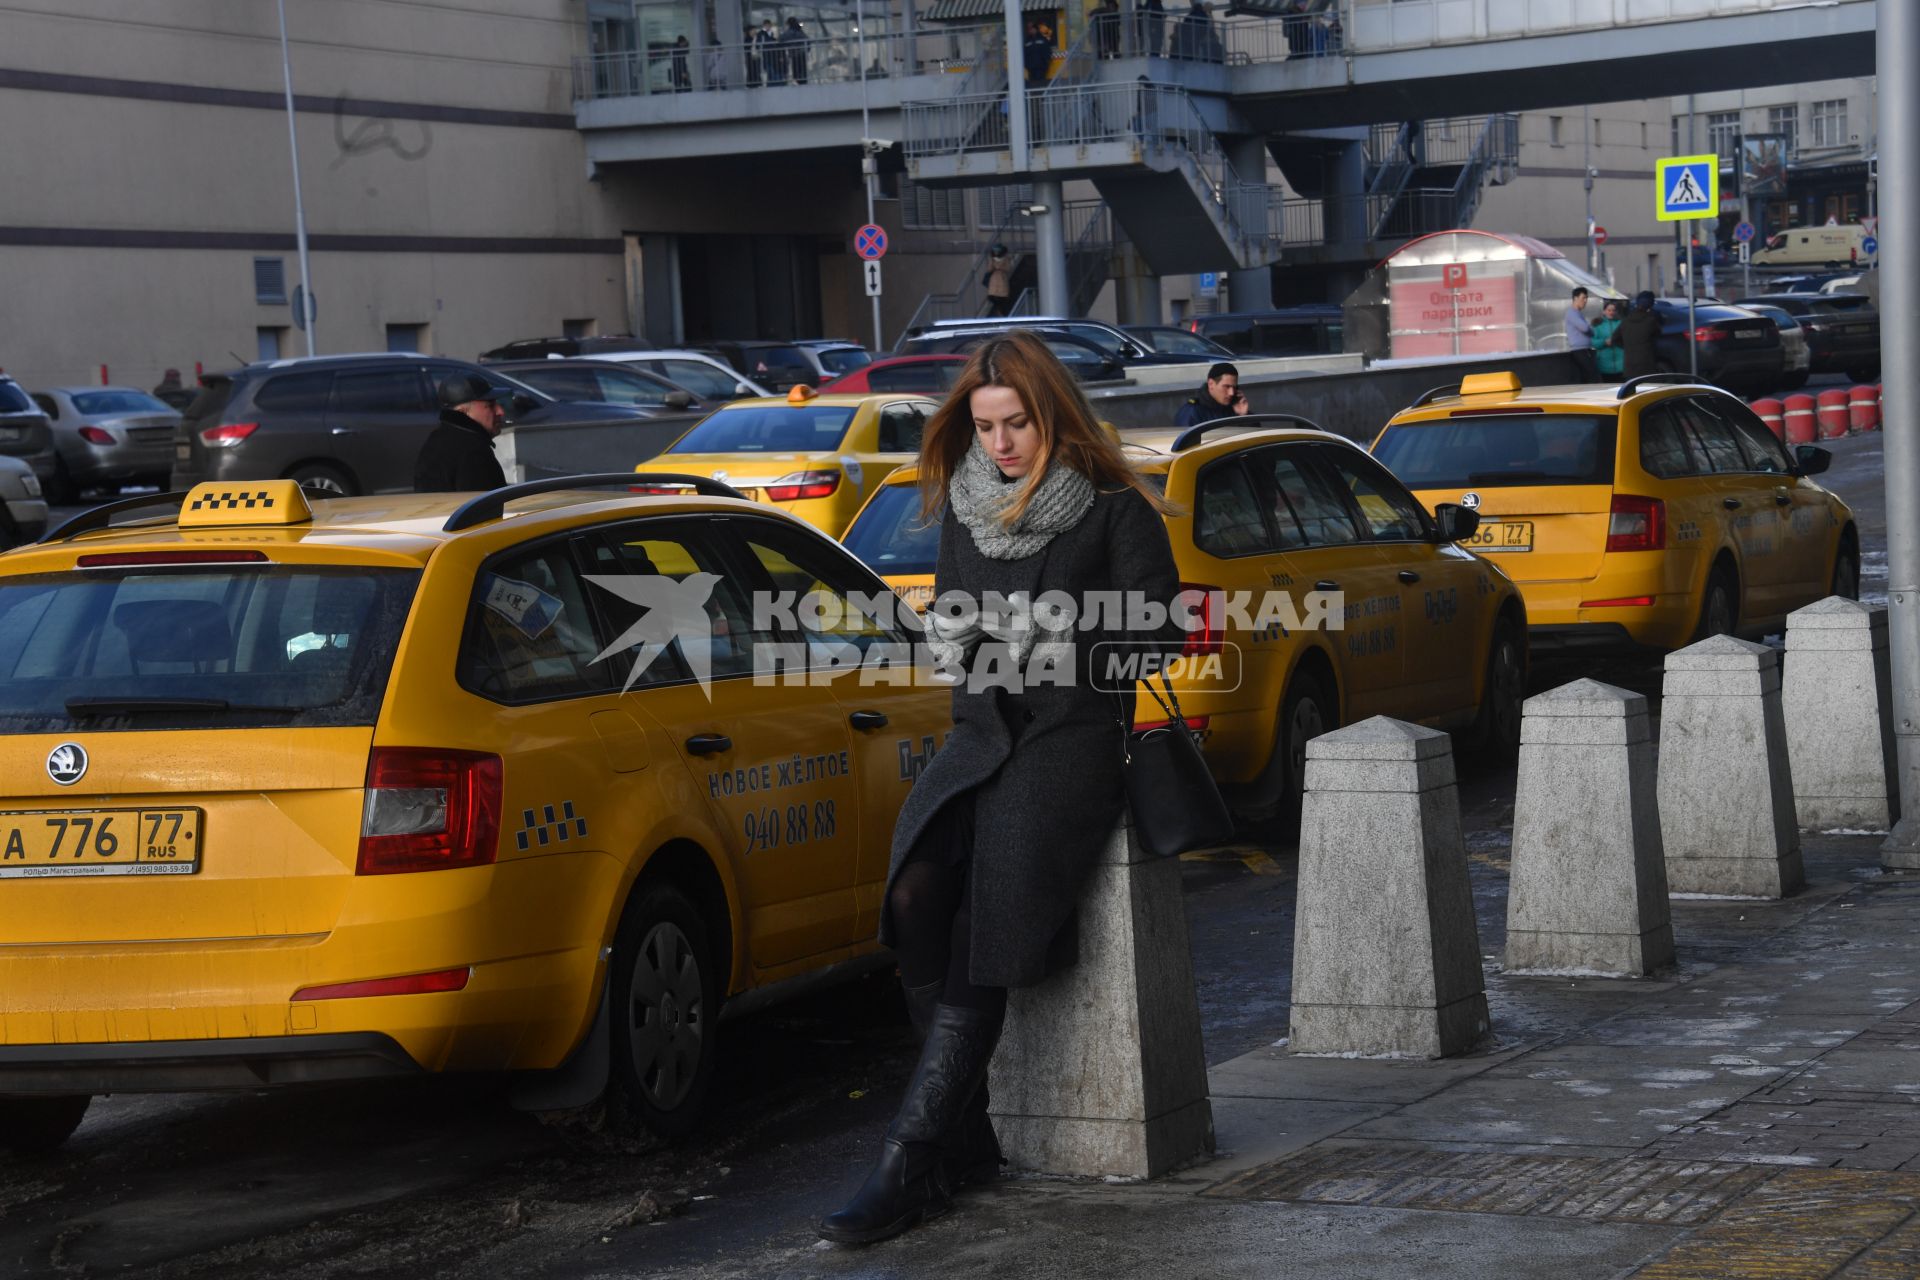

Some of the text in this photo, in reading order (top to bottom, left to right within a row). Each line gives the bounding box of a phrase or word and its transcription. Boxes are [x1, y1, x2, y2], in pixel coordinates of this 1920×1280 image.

[1449, 267, 1463, 283] P
[1430, 292, 1484, 305] Оплата
[1422, 306, 1492, 321] парковки
[1506, 525, 1524, 539] 77
[708, 751, 849, 799] НОВОЕ ЖЁЛТОЕ
[744, 799, 836, 856] 940 88 88
[47, 817, 118, 858] 776
[145, 814, 183, 844] 77
[148, 846, 176, 858] RUS
[23, 865, 190, 876] РОЛЬФ Магистральный (495) 980-59-59
